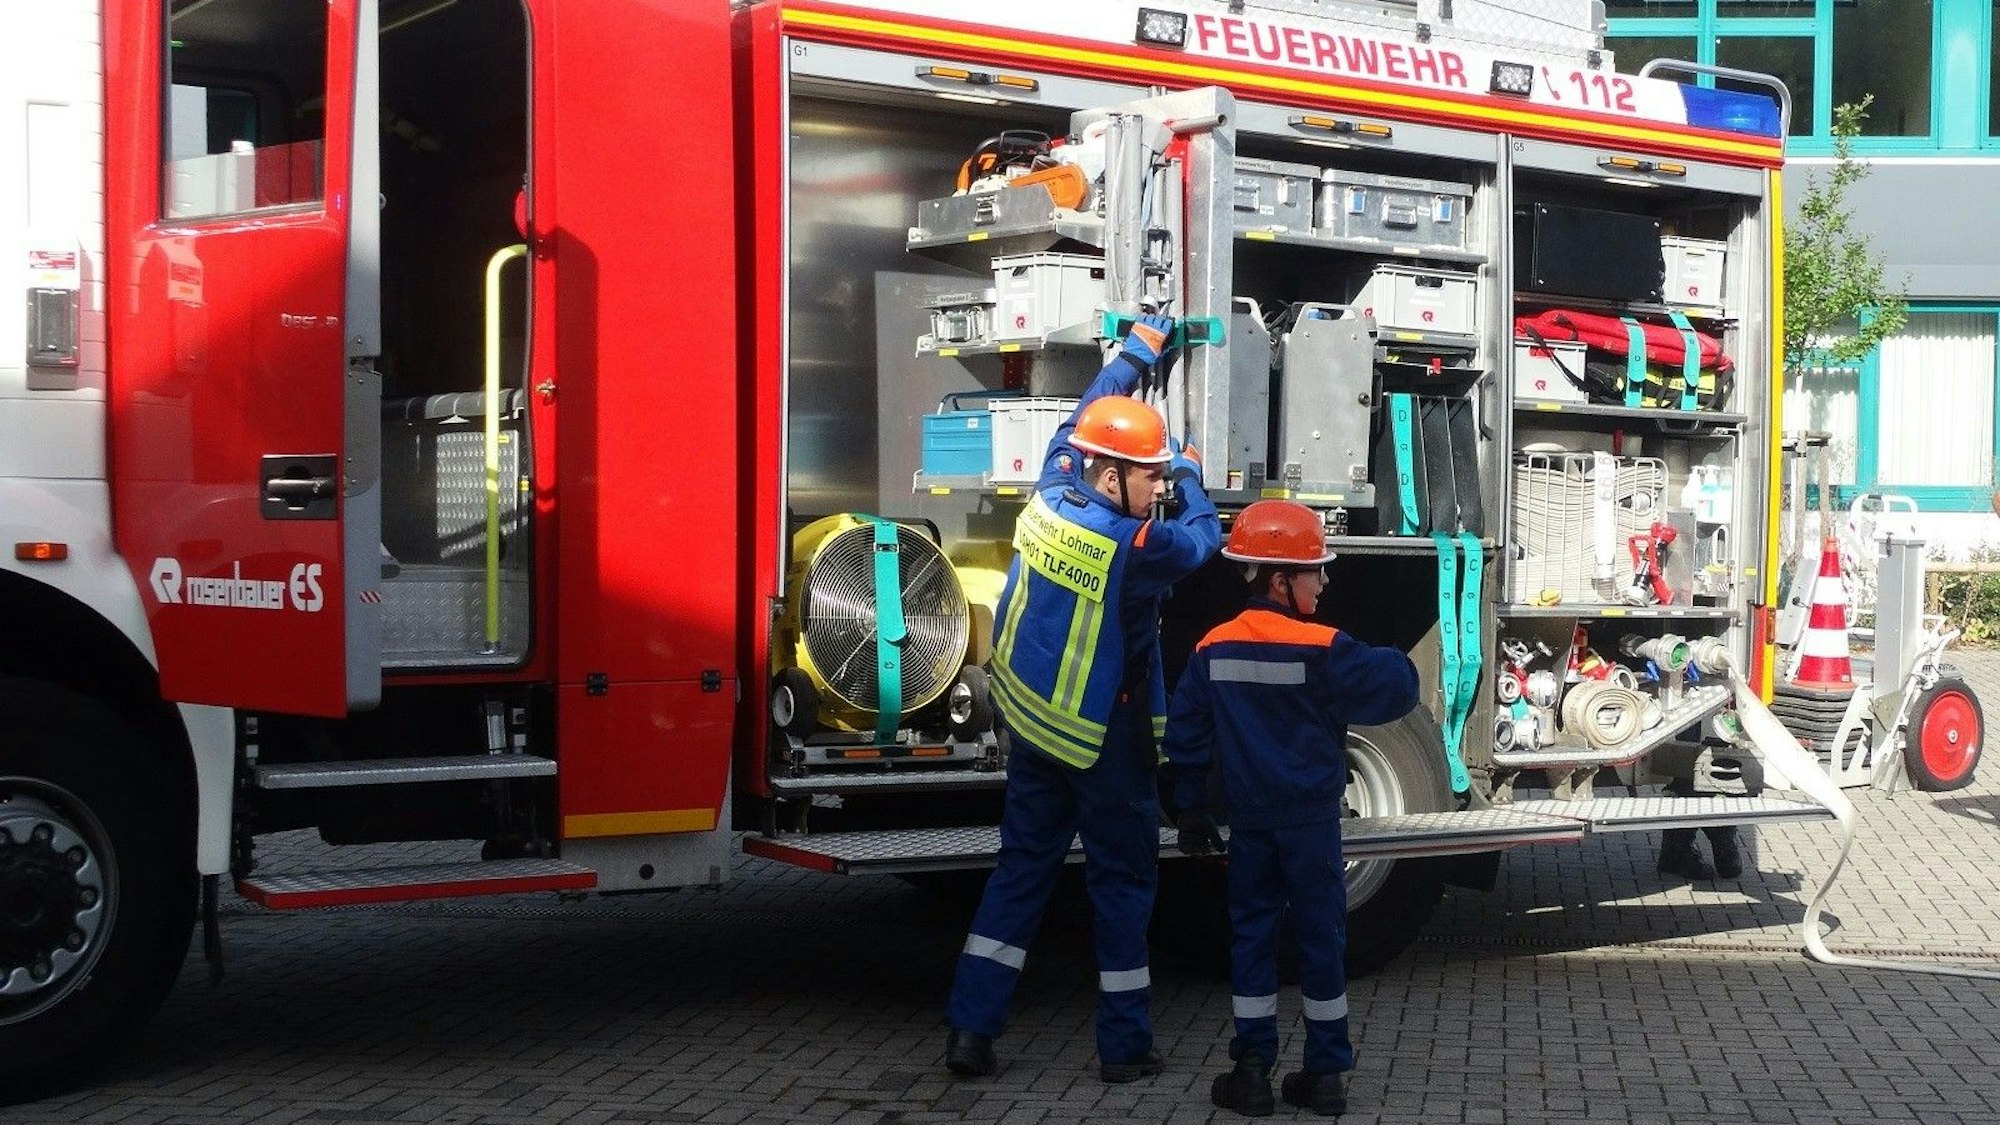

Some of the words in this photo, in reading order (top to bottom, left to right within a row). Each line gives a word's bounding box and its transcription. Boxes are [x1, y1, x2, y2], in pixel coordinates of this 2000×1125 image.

[794, 44, 807, 56] G1
[1194, 14, 1468, 88] FEUERWEHR
[1569, 72, 1637, 112] 112
[1513, 142, 1525, 152] G5
[1060, 528, 1107, 562] Lohmar
[187, 560, 286, 610] rosenbauer
[290, 563, 324, 613] ES
[1043, 551, 1100, 592] TLF4000
